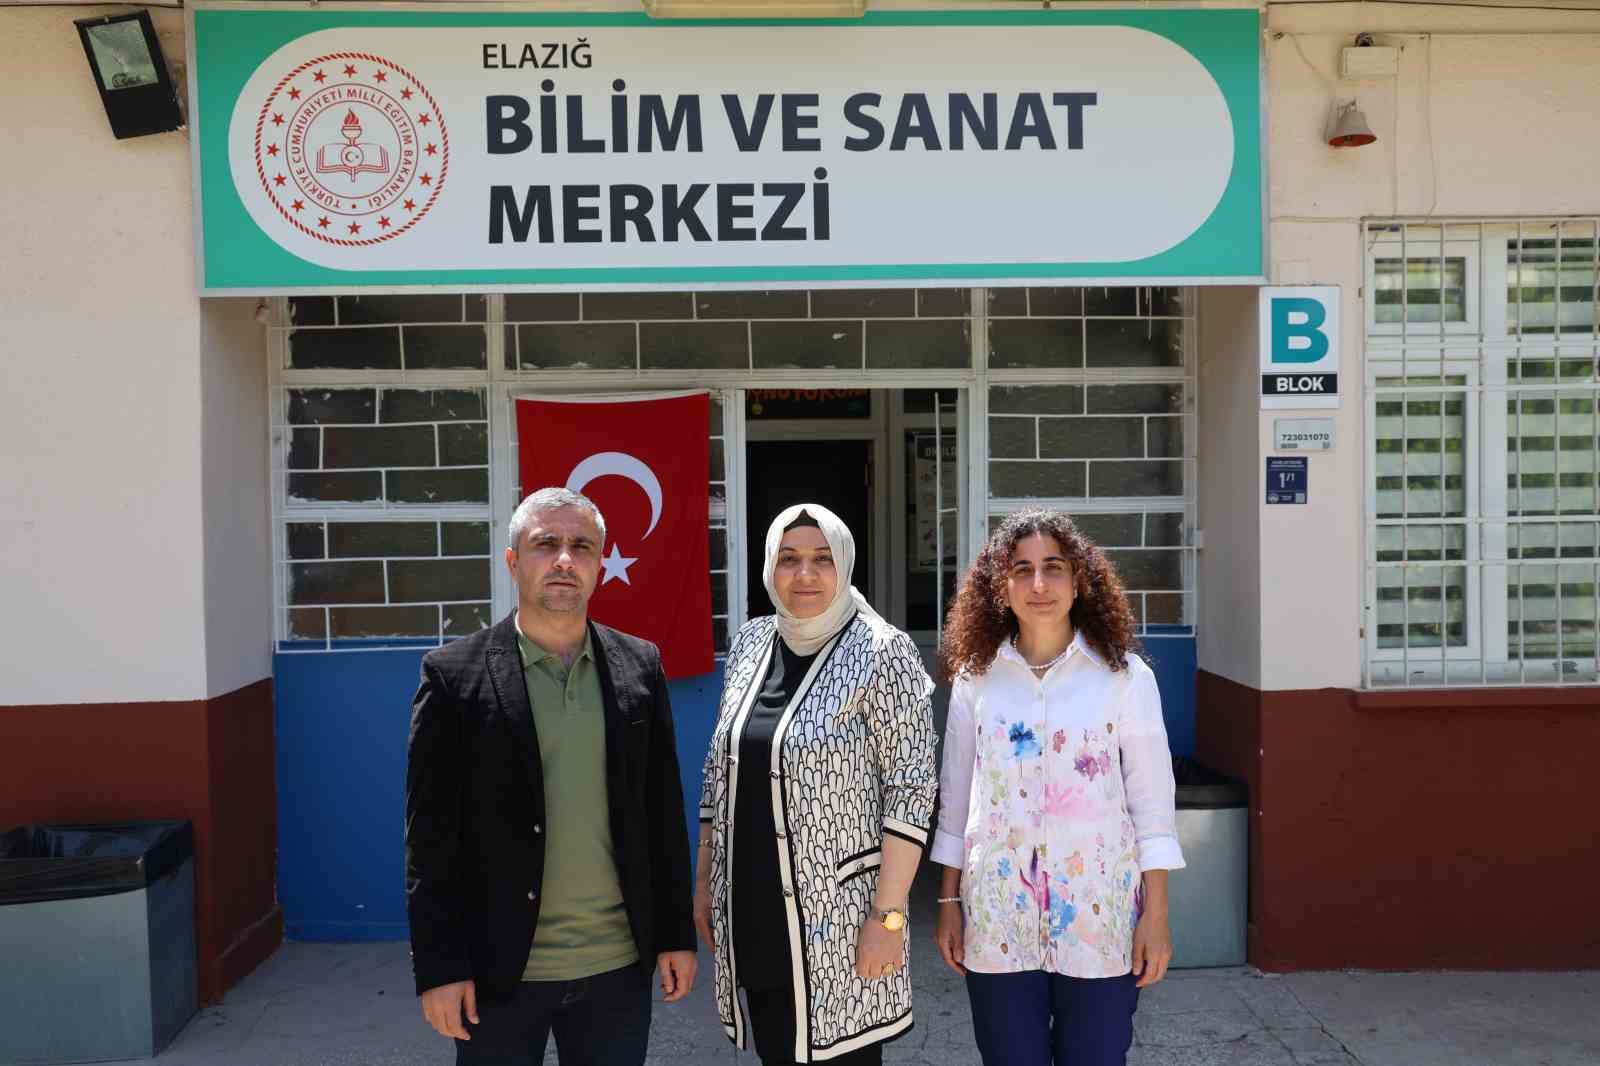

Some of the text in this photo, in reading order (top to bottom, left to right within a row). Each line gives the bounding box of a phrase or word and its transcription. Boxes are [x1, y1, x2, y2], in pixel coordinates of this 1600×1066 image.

[482, 37, 592, 69] ELAZIĞ
[486, 78, 1098, 155] BİLİM VE SANAT
[295, 167, 341, 209] TÜRKİYE
[368, 150, 413, 208] BAKANLIĞI
[489, 166, 830, 245] MERKEZİ
[1271, 297, 1329, 363] B
[1276, 377, 1324, 392] BLOK
